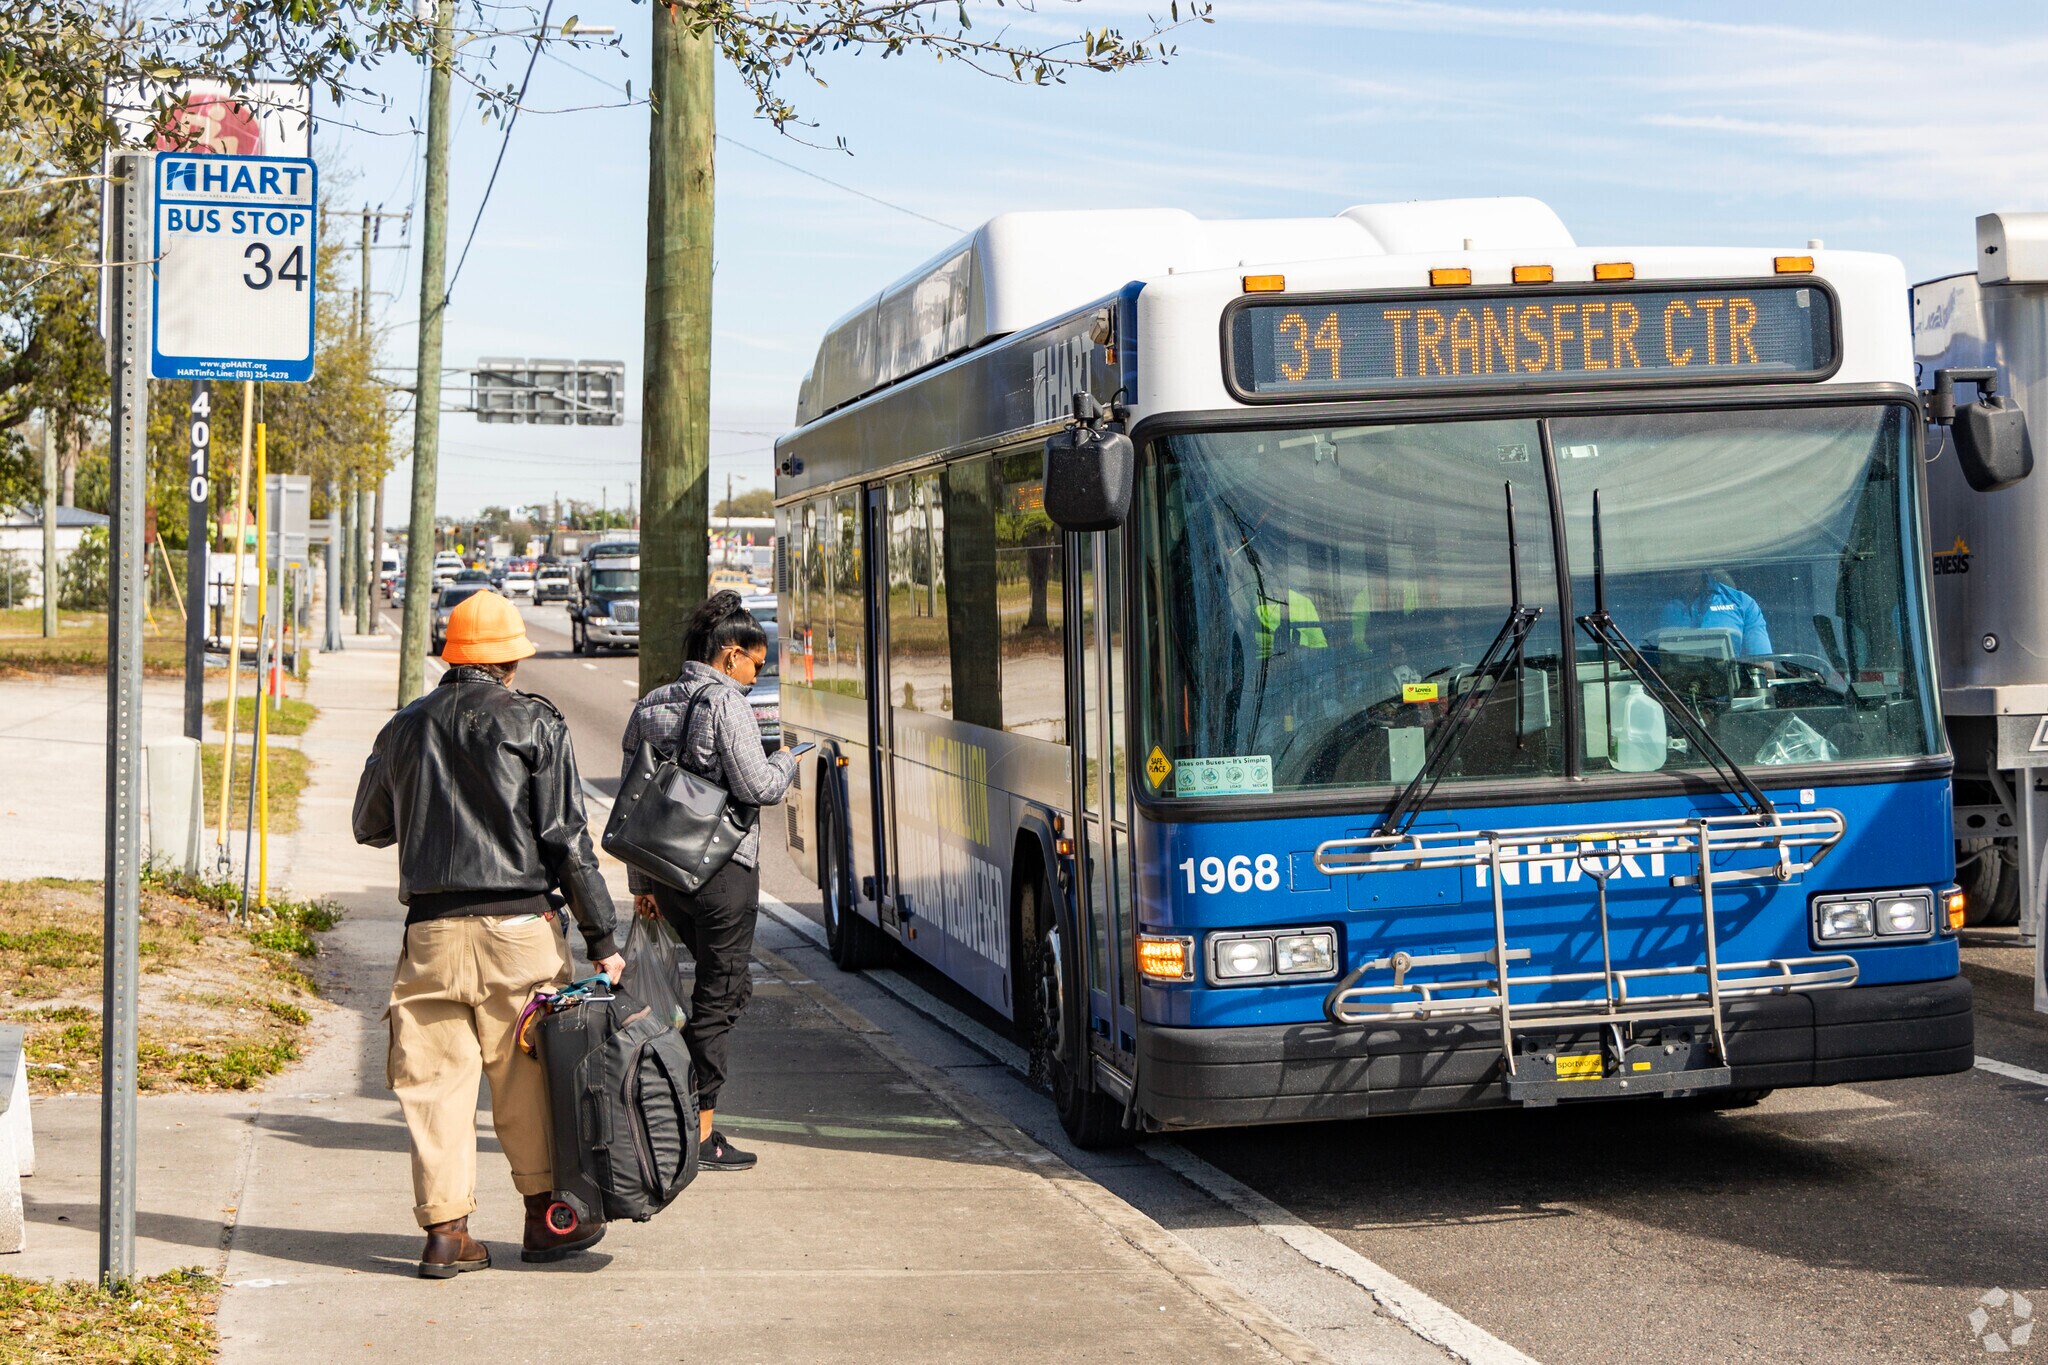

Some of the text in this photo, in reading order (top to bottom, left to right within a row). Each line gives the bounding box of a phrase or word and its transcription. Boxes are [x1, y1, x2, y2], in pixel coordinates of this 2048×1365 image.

[203, 163, 306, 195] HART
[168, 208, 305, 236] BUS STOP
[243, 242, 308, 292] 34
[1280, 298, 1758, 381] 34 TRANSFER CTR
[177, 369, 289, 380] HARTinfo Line: (813) 254-4278
[200, 361, 267, 371] www.goHART.org
[1047, 331, 1095, 425] HART
[191, 391, 211, 503] 4010
[1933, 554, 1970, 576] ENESIS
[1150, 757, 1163, 766] SAFE
[1178, 760, 1194, 768] Bikes
[1244, 757, 1268, 765] Simple:
[906, 726, 930, 823] COOL
[947, 739, 990, 848] BILLION
[1179, 853, 1280, 895] 1968
[1527, 837, 1675, 885] HART
[900, 823, 1007, 969] DOLLARS RECOVERED
[1557, 1058, 1601, 1069] sportworks
